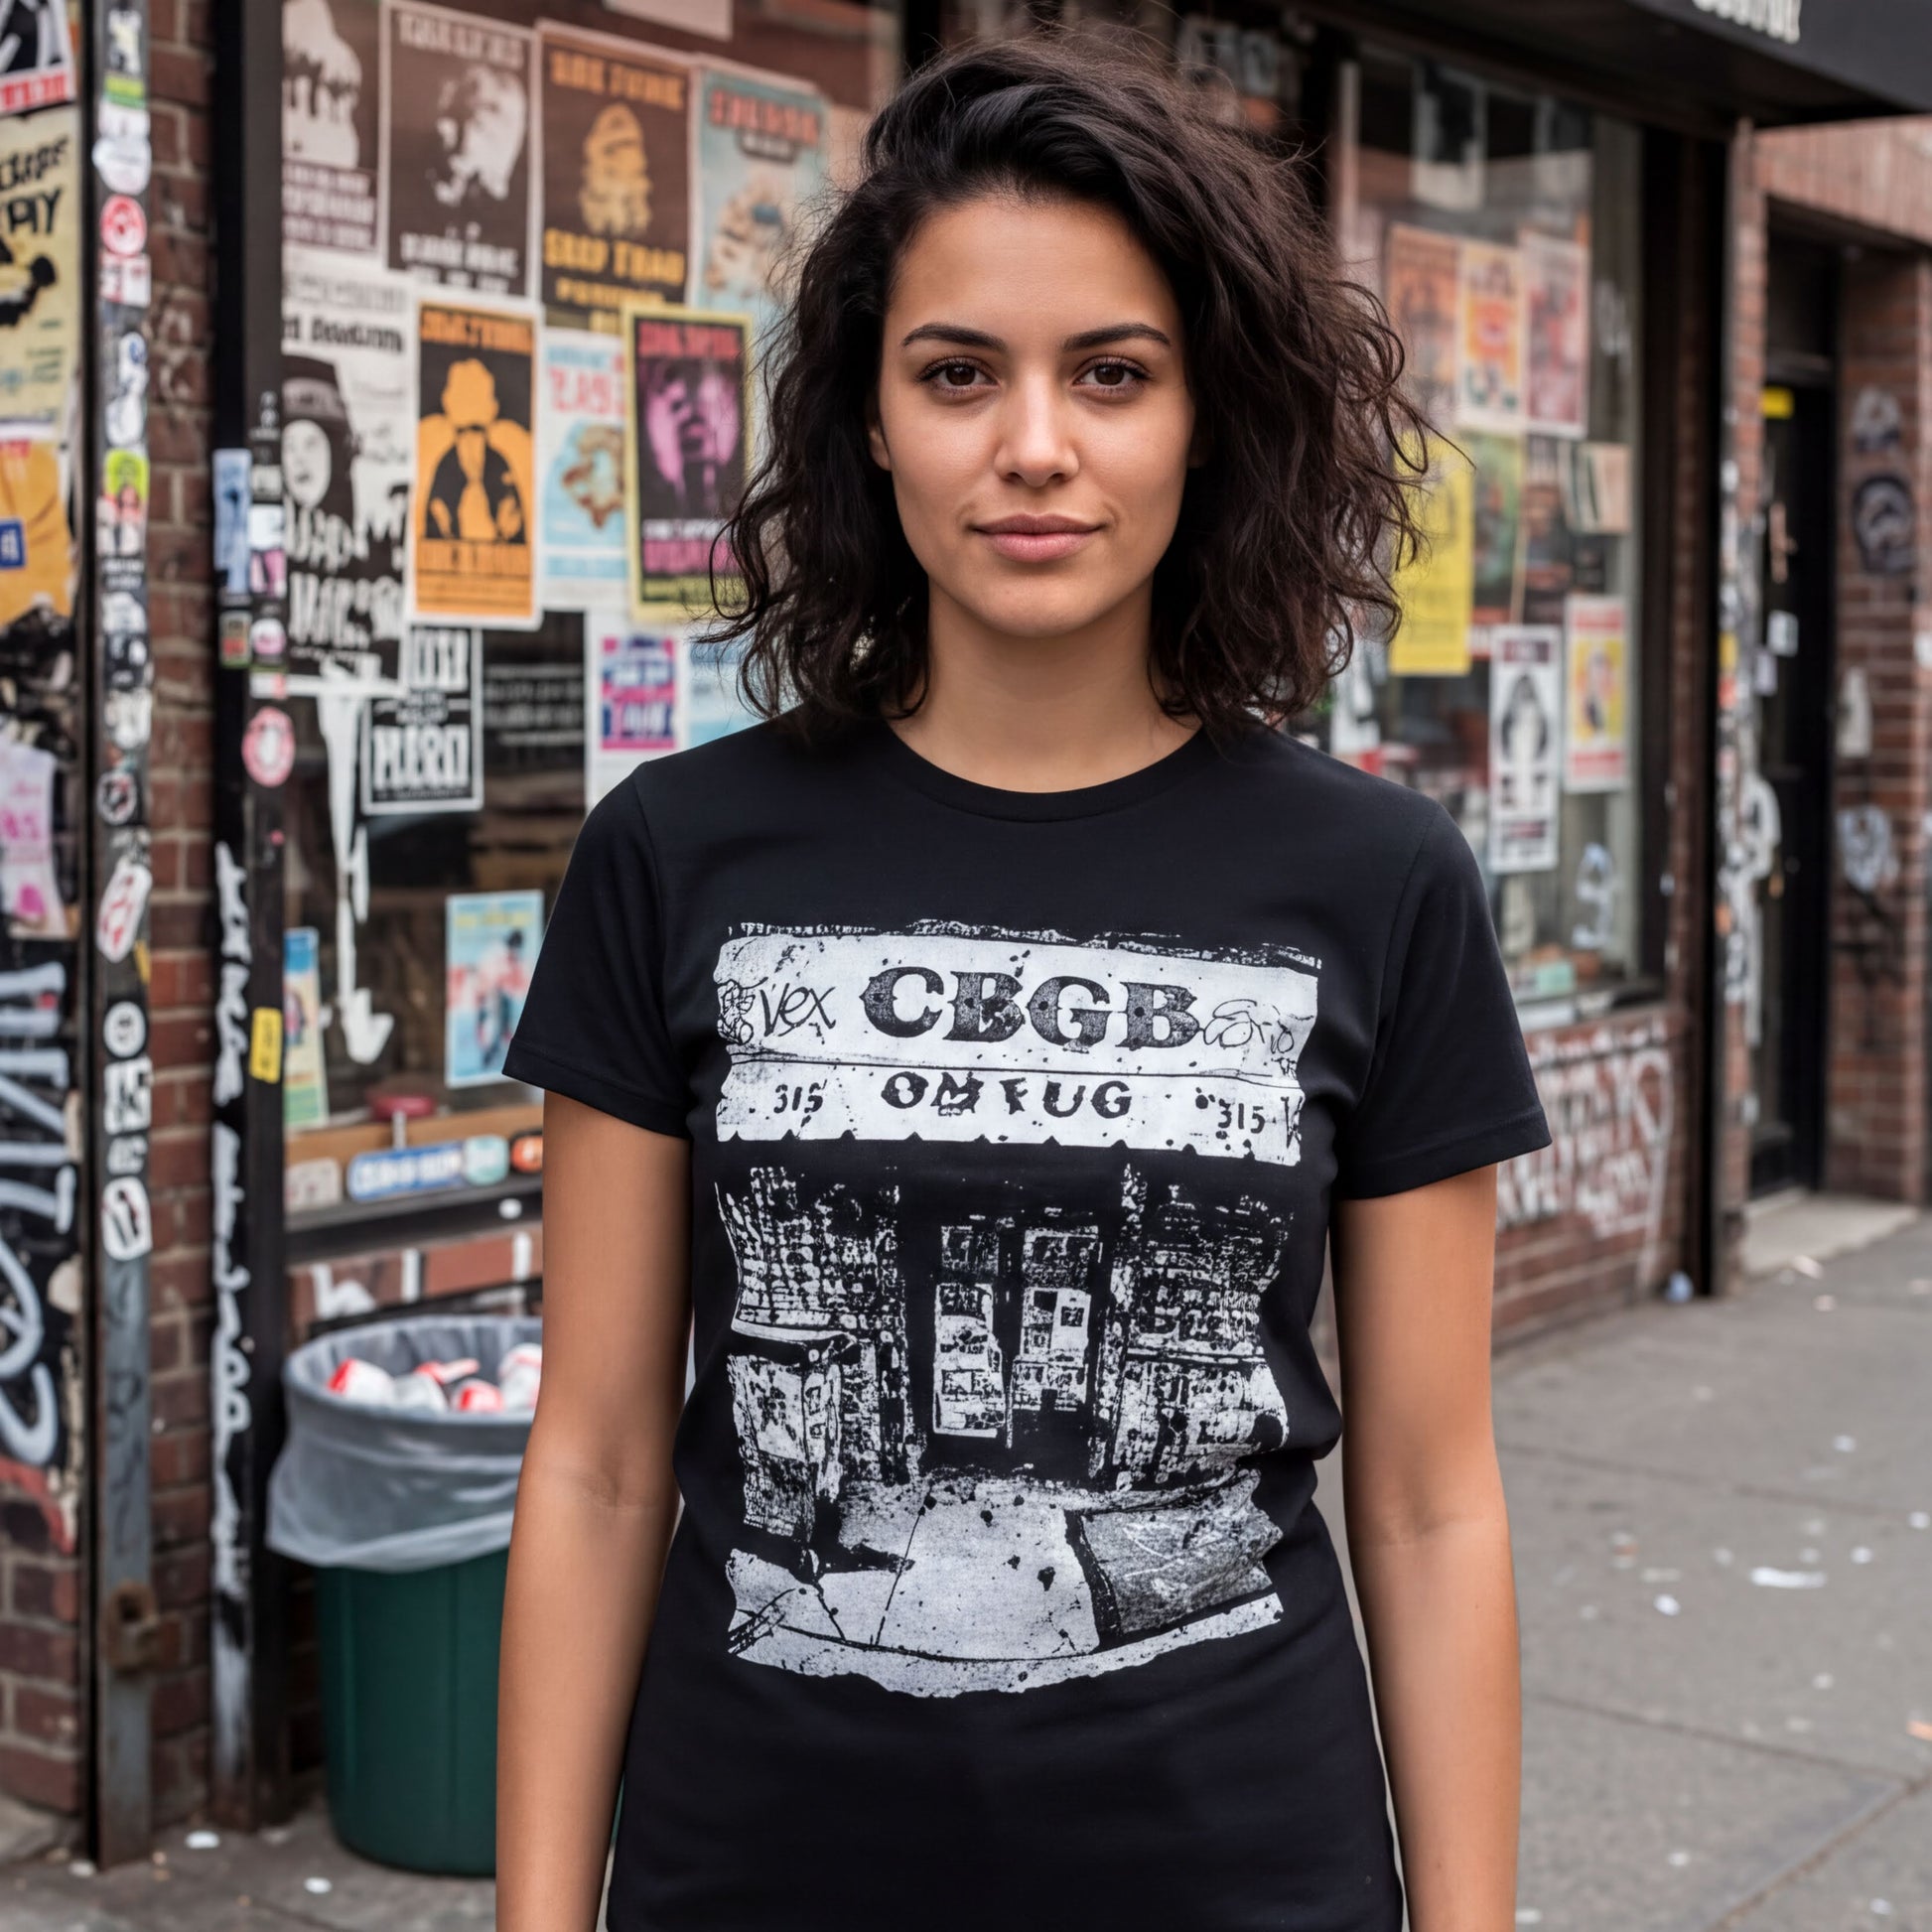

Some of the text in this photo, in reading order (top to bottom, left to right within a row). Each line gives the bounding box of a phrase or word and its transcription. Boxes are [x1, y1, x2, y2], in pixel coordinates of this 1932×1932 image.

[759, 982, 836, 1037] Vex
[859, 966, 1200, 1048] CBGB
[773, 1082, 823, 1114] 315
[1218, 1098, 1266, 1134] 315
